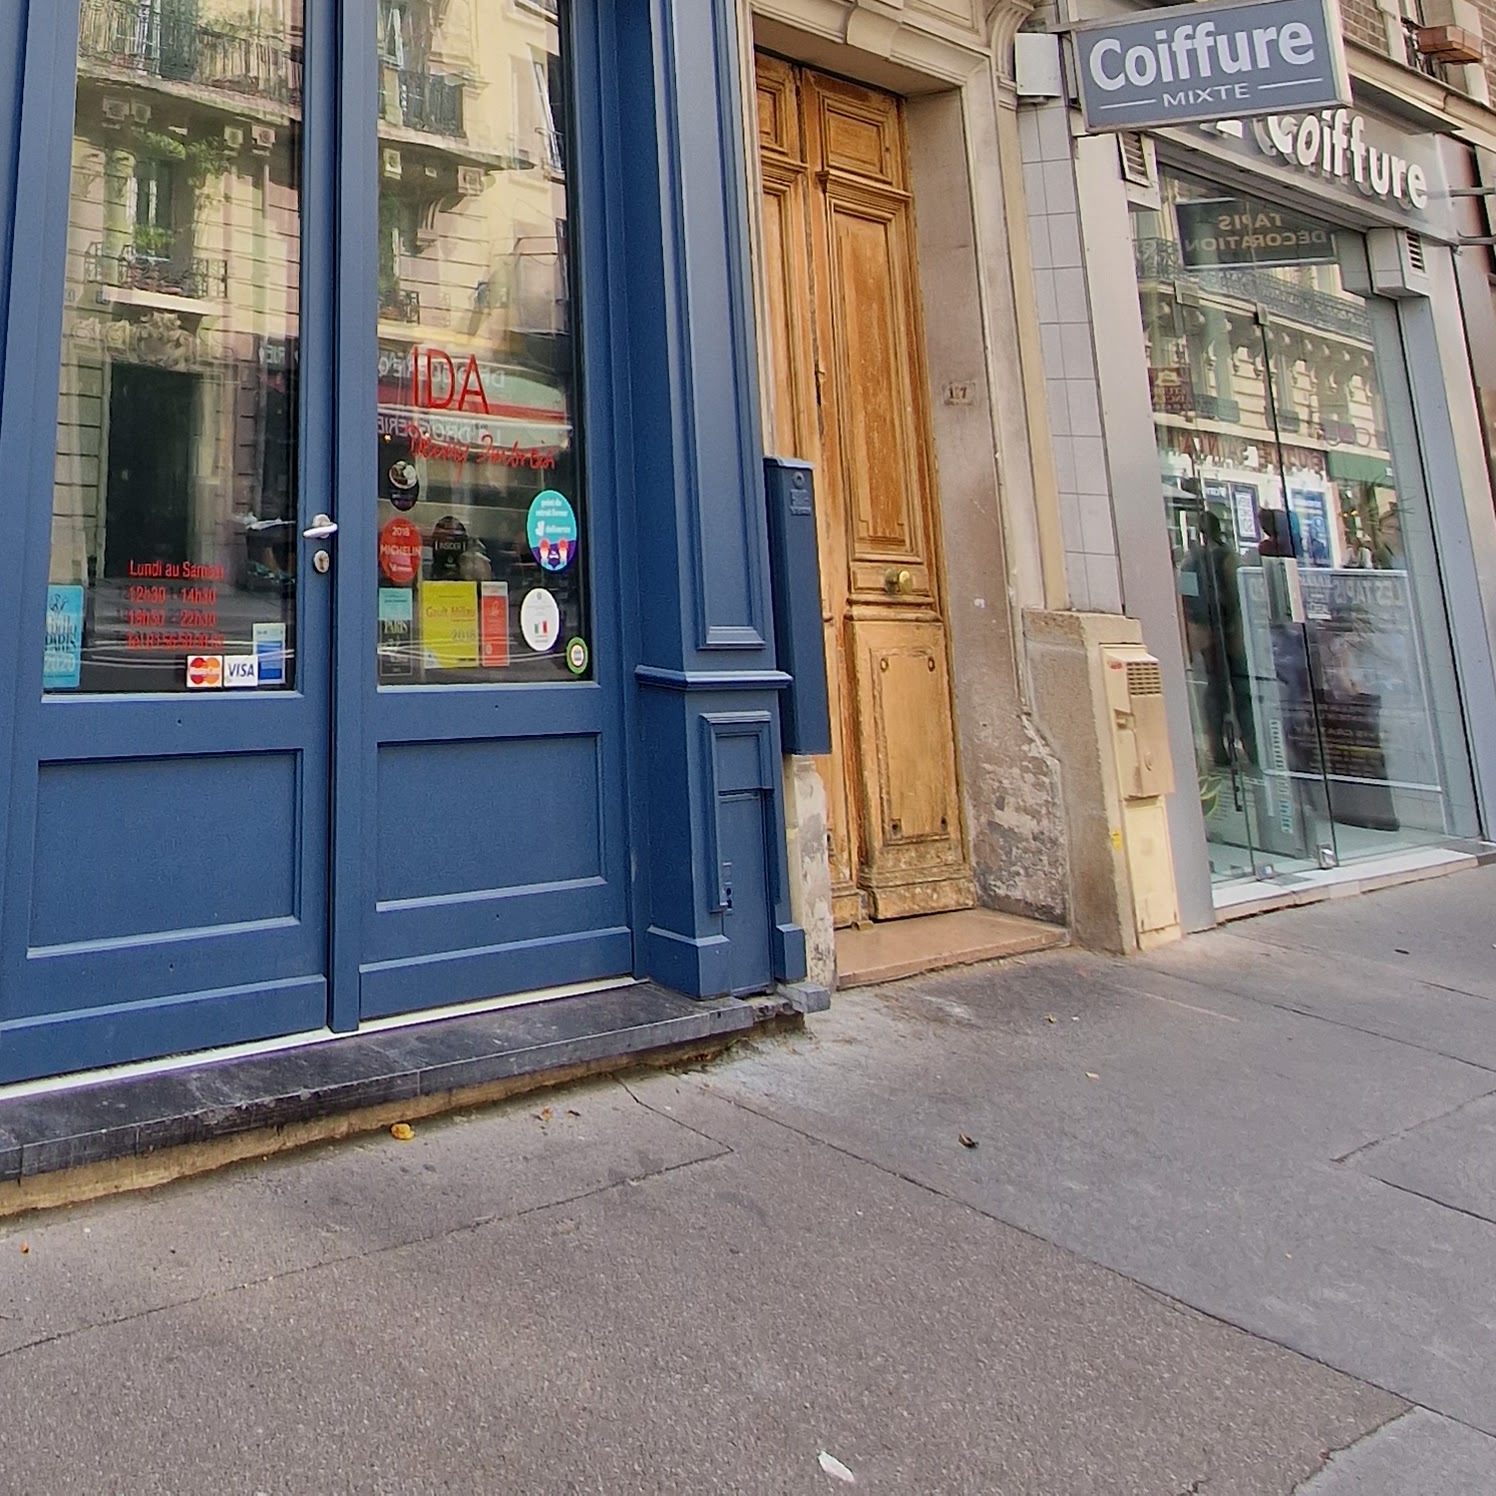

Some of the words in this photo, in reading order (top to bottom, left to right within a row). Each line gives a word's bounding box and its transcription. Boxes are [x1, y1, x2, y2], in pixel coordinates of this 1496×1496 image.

[1088, 19, 1315, 92] Coiffure
[1162, 81, 1251, 109] MIXTE
[1262, 108, 1429, 210] Coiffure
[412, 345, 489, 415] IDA
[380, 544, 421, 555] MICHELIN
[129, 559, 163, 576] Lundi
[165, 564, 179, 577] au
[227, 663, 255, 678] VISA
